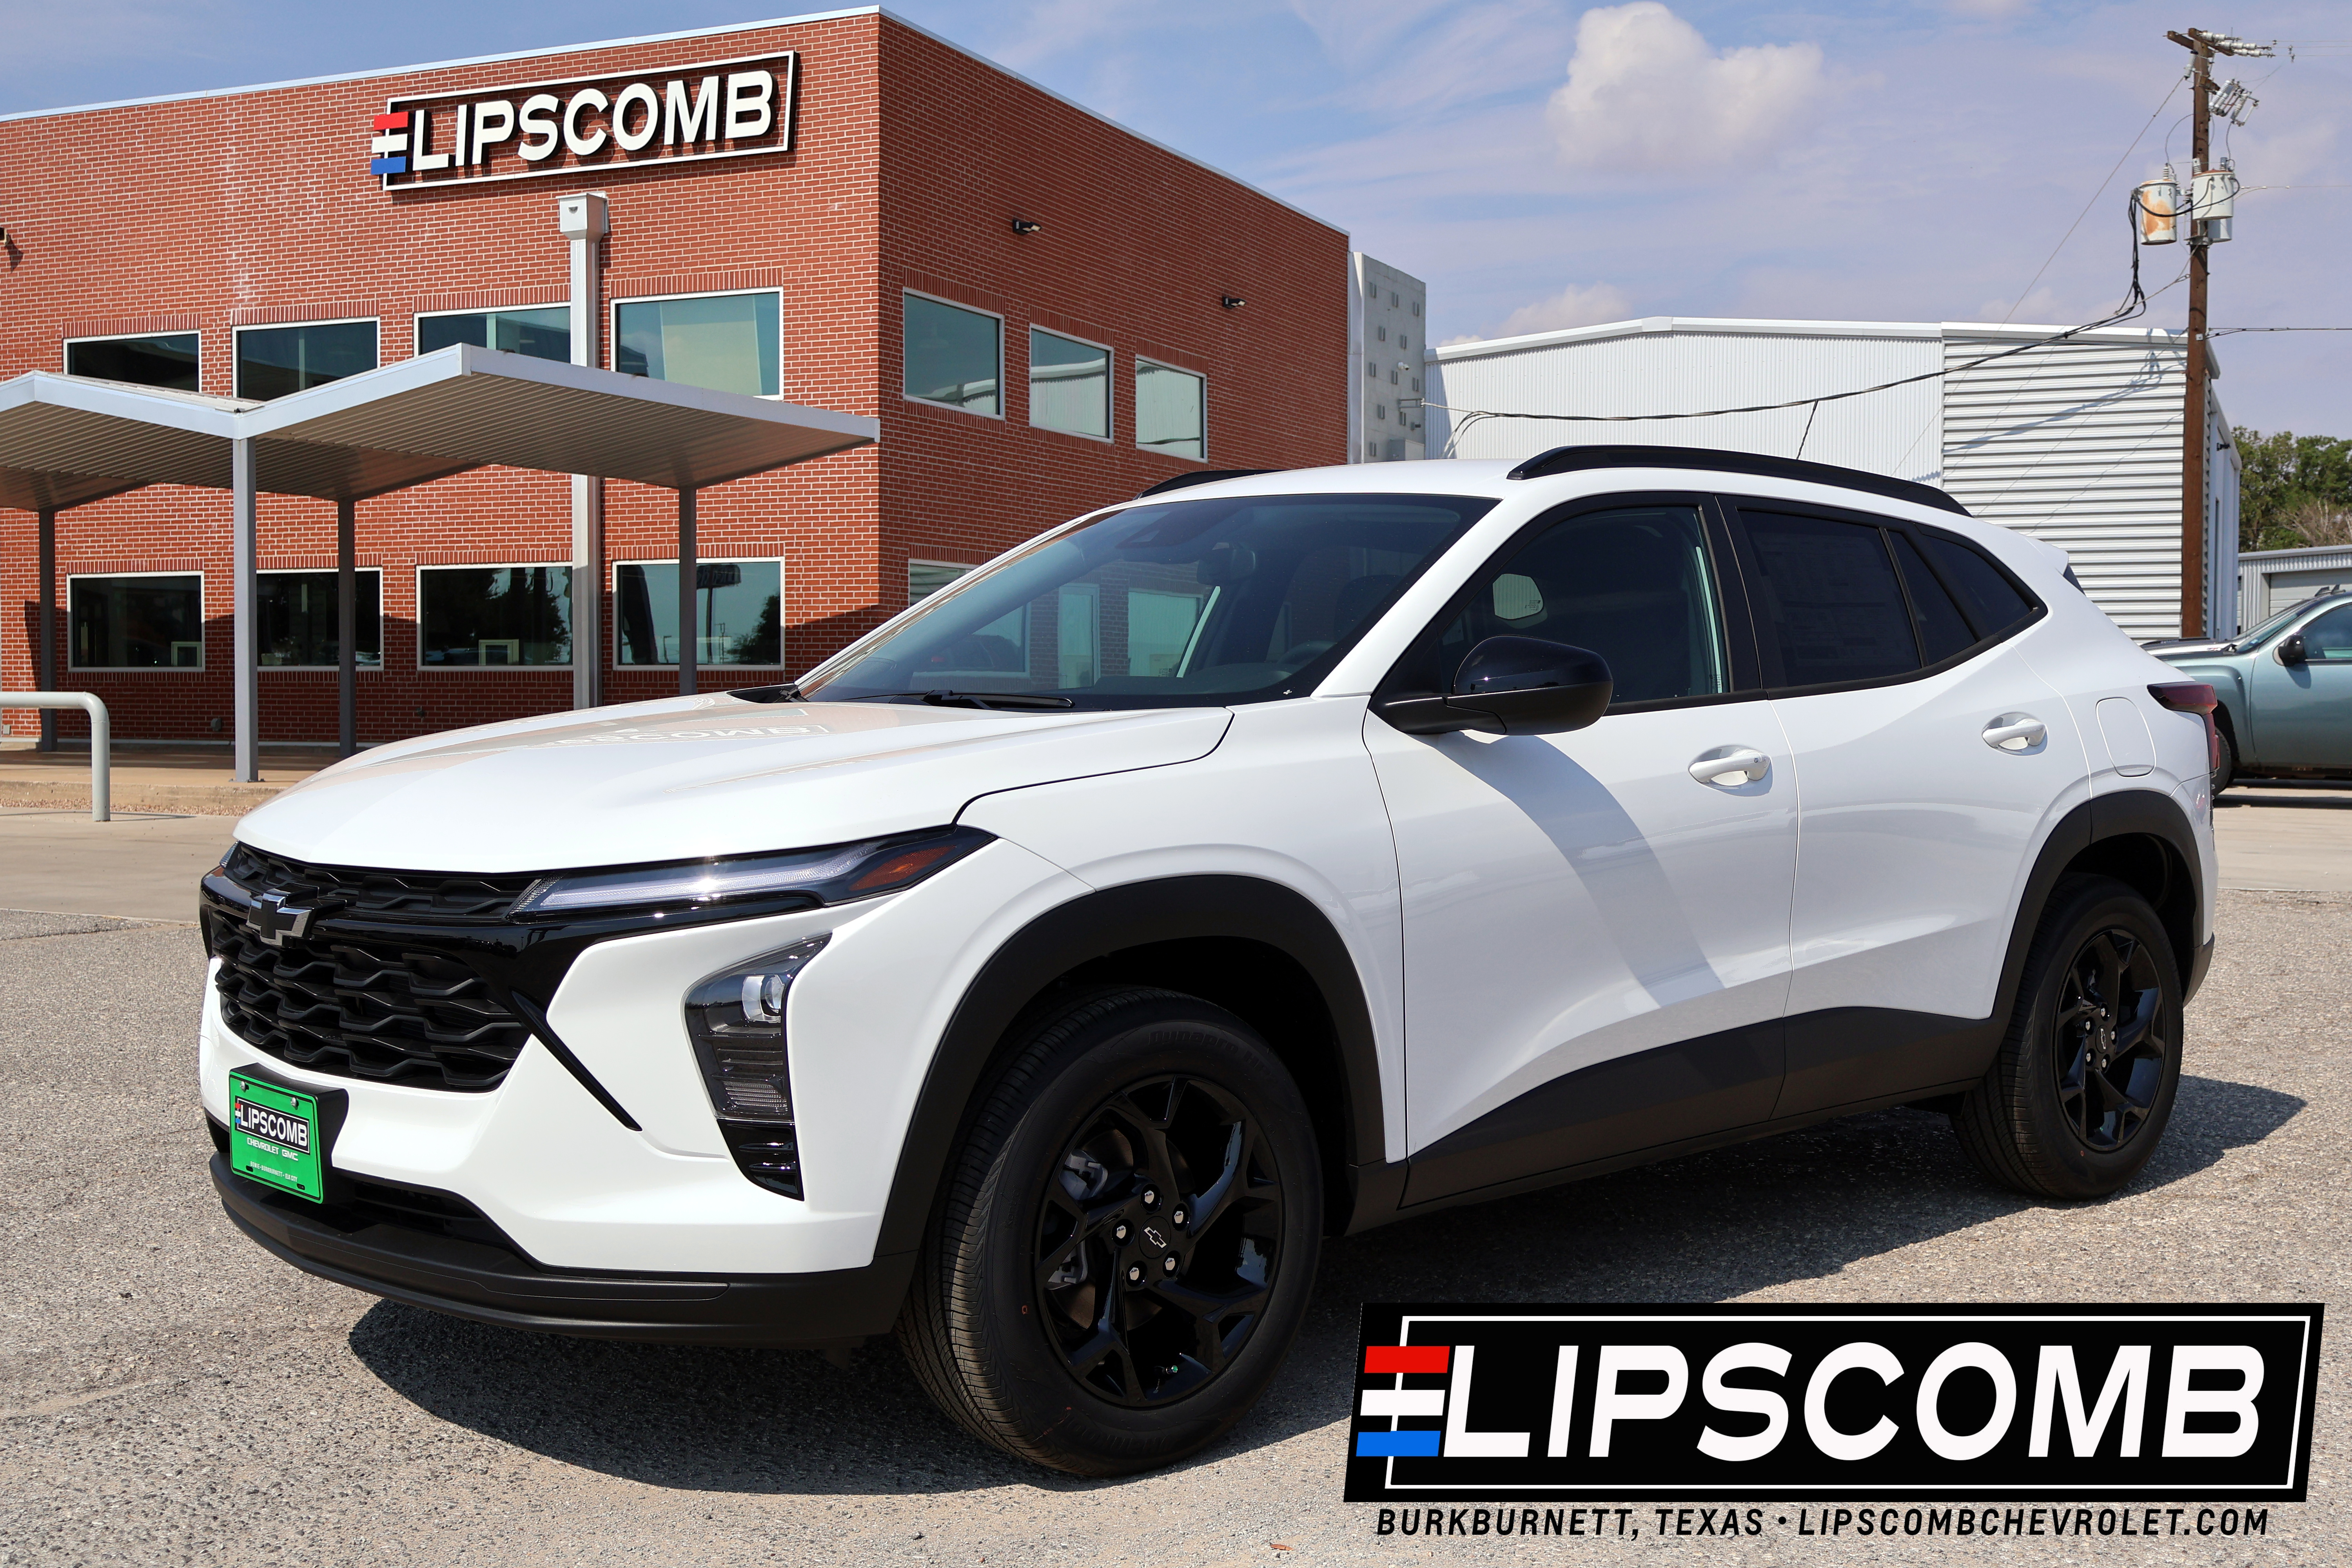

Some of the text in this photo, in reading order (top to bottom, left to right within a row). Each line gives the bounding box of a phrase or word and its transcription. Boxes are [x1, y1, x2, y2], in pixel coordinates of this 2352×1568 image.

[412, 71, 773, 171] LIPSCOMB
[1148, 1030, 1239, 1055] Dynapro
[241, 1104, 307, 1147] LIPSCOMB
[247, 1137, 298, 1161] CHEVROLET GMC
[250, 1161, 260, 1169] BOWIE
[261, 1165, 283, 1177] BURKBURNETT
